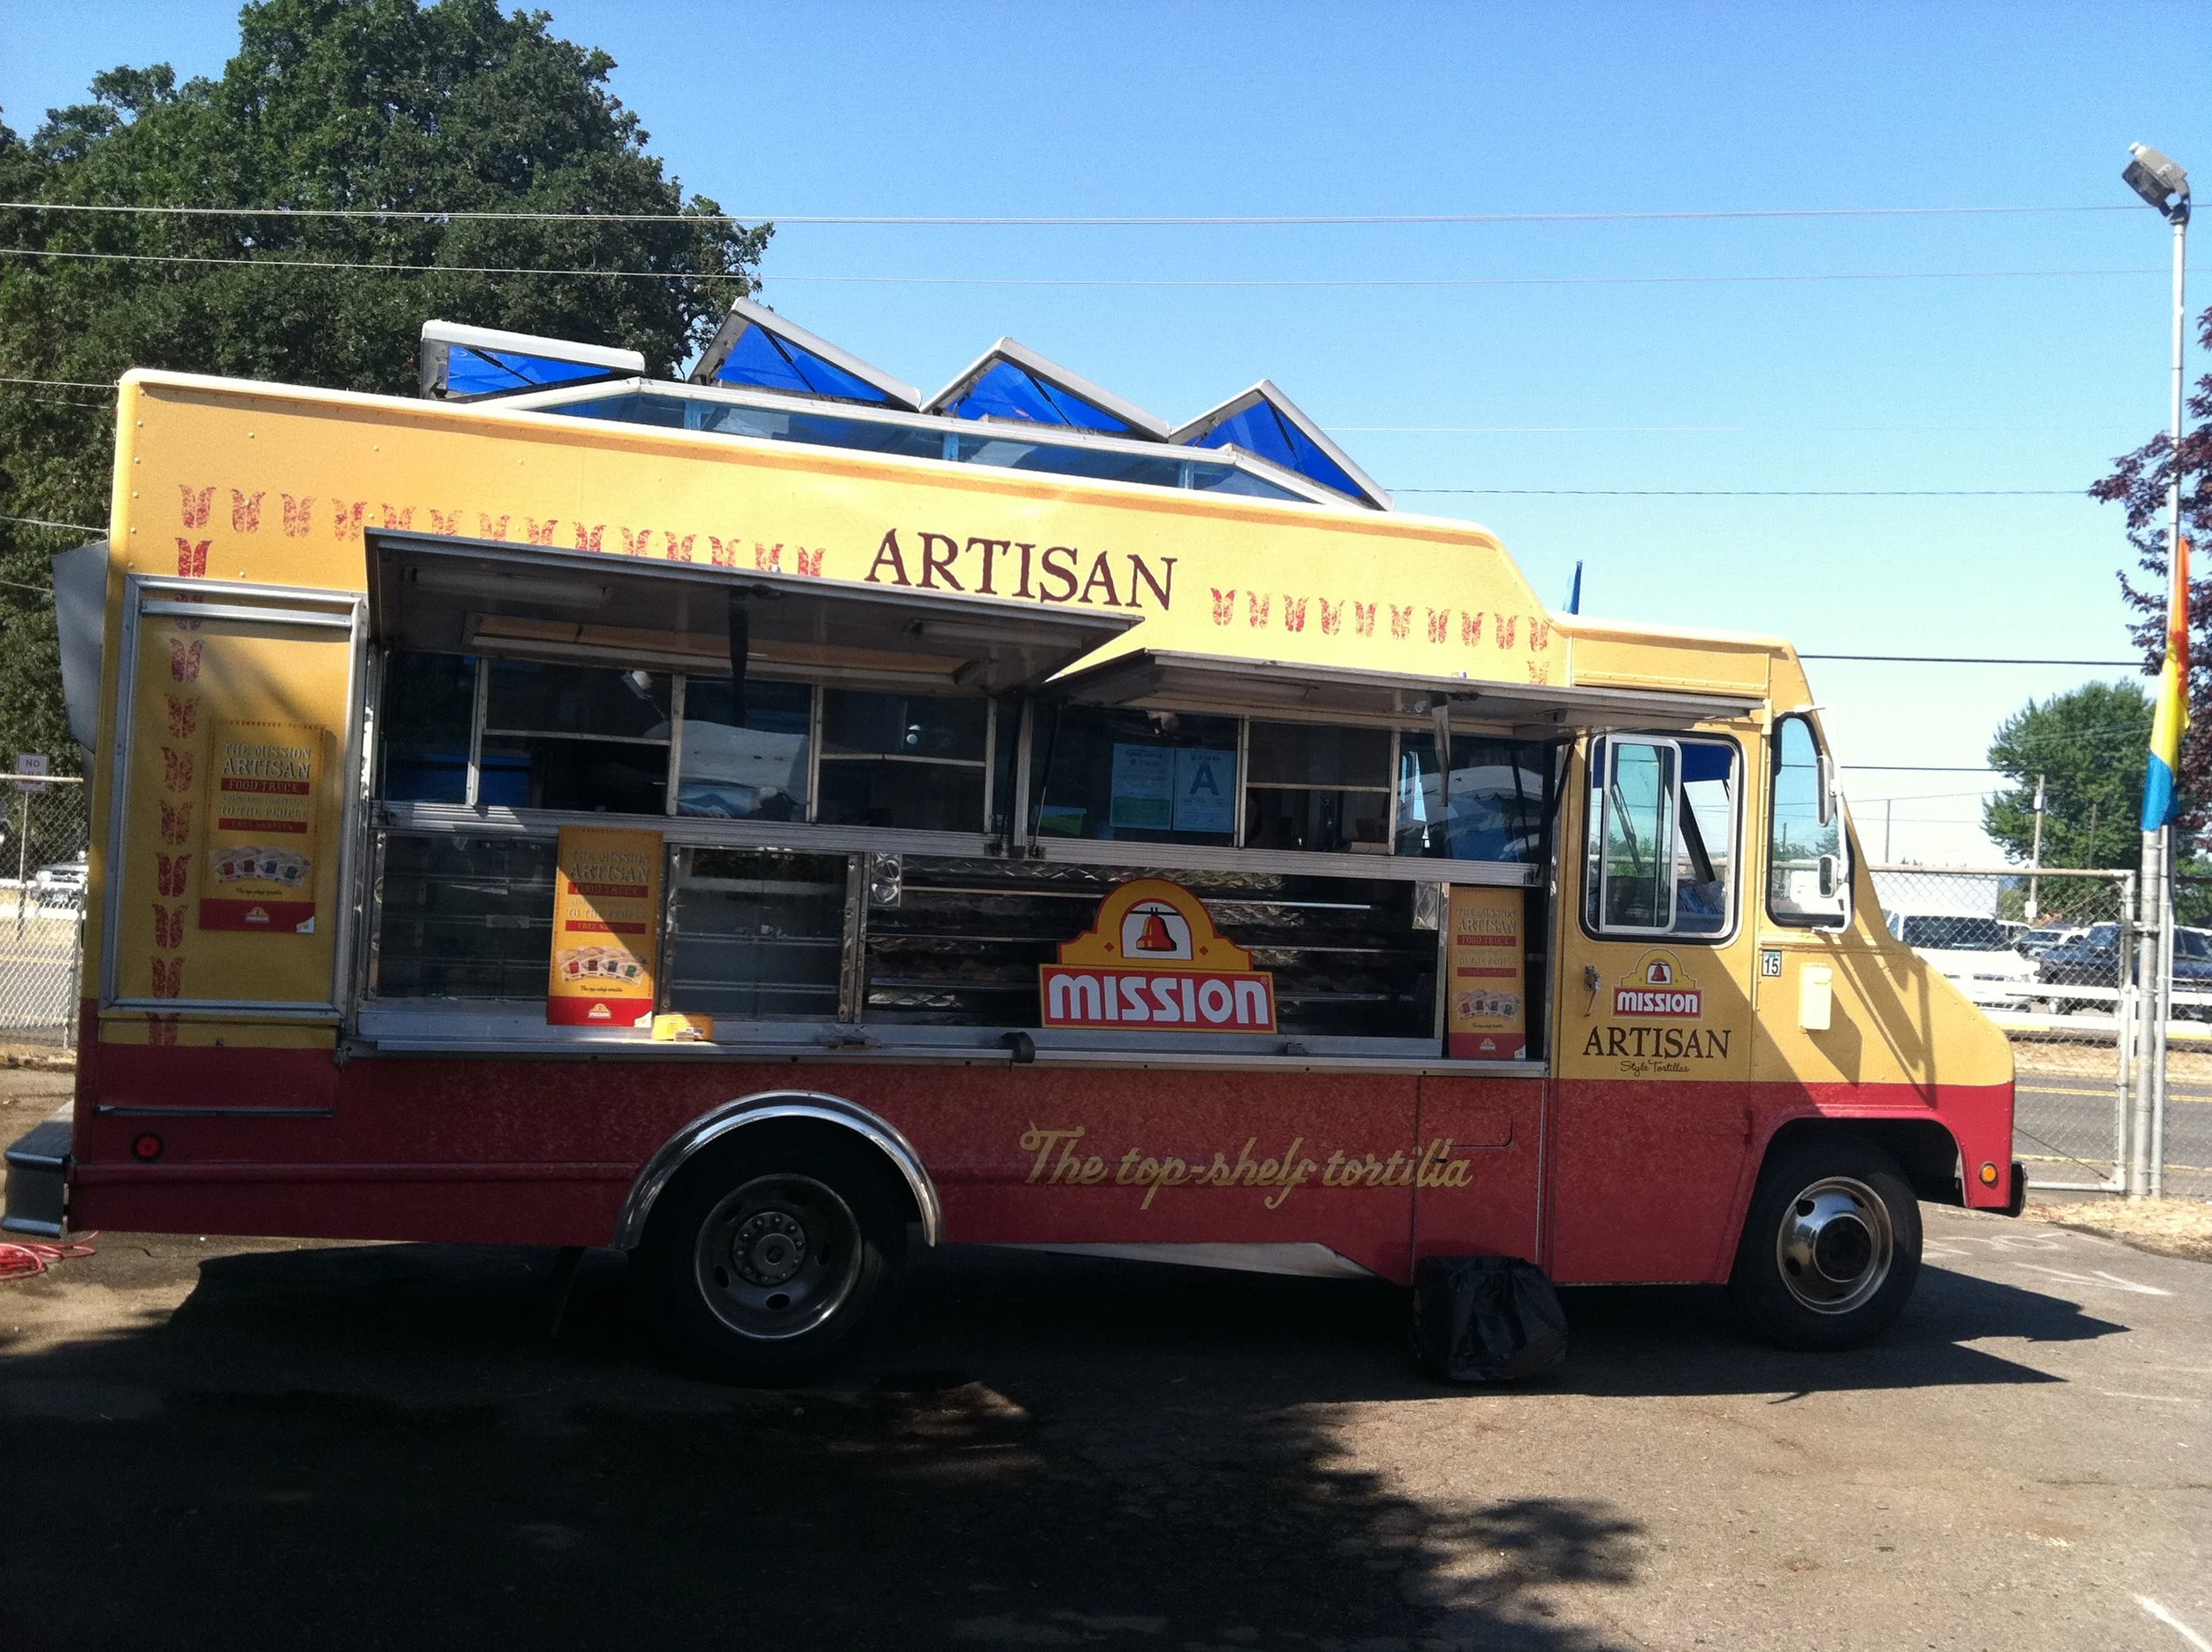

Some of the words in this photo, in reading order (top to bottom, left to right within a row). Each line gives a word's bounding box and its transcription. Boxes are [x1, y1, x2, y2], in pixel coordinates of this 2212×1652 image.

[864, 527, 1178, 611] ARTISAN
[256, 744, 311, 759] MISSION
[25, 758, 41, 768] NO
[224, 757, 311, 779] ARTISAN
[229, 779, 258, 791] FOOD
[1189, 761, 1219, 795] A
[570, 863, 650, 883] ARTISAN
[1457, 918, 1517, 934] ARTISAN
[1764, 957, 1779, 974] 15
[1048, 974, 1269, 1025] MISSION
[1617, 991, 1698, 1013] MISSION
[1582, 1026, 1732, 1059] ARTISAN
[1620, 1061, 1649, 1077] Style
[1648, 1060, 1691, 1073] Tortillas
[1019, 1120, 1109, 1185] The
[1115, 1136, 1317, 1210] top-shelf
[1321, 1138, 1474, 1189] tortilla
